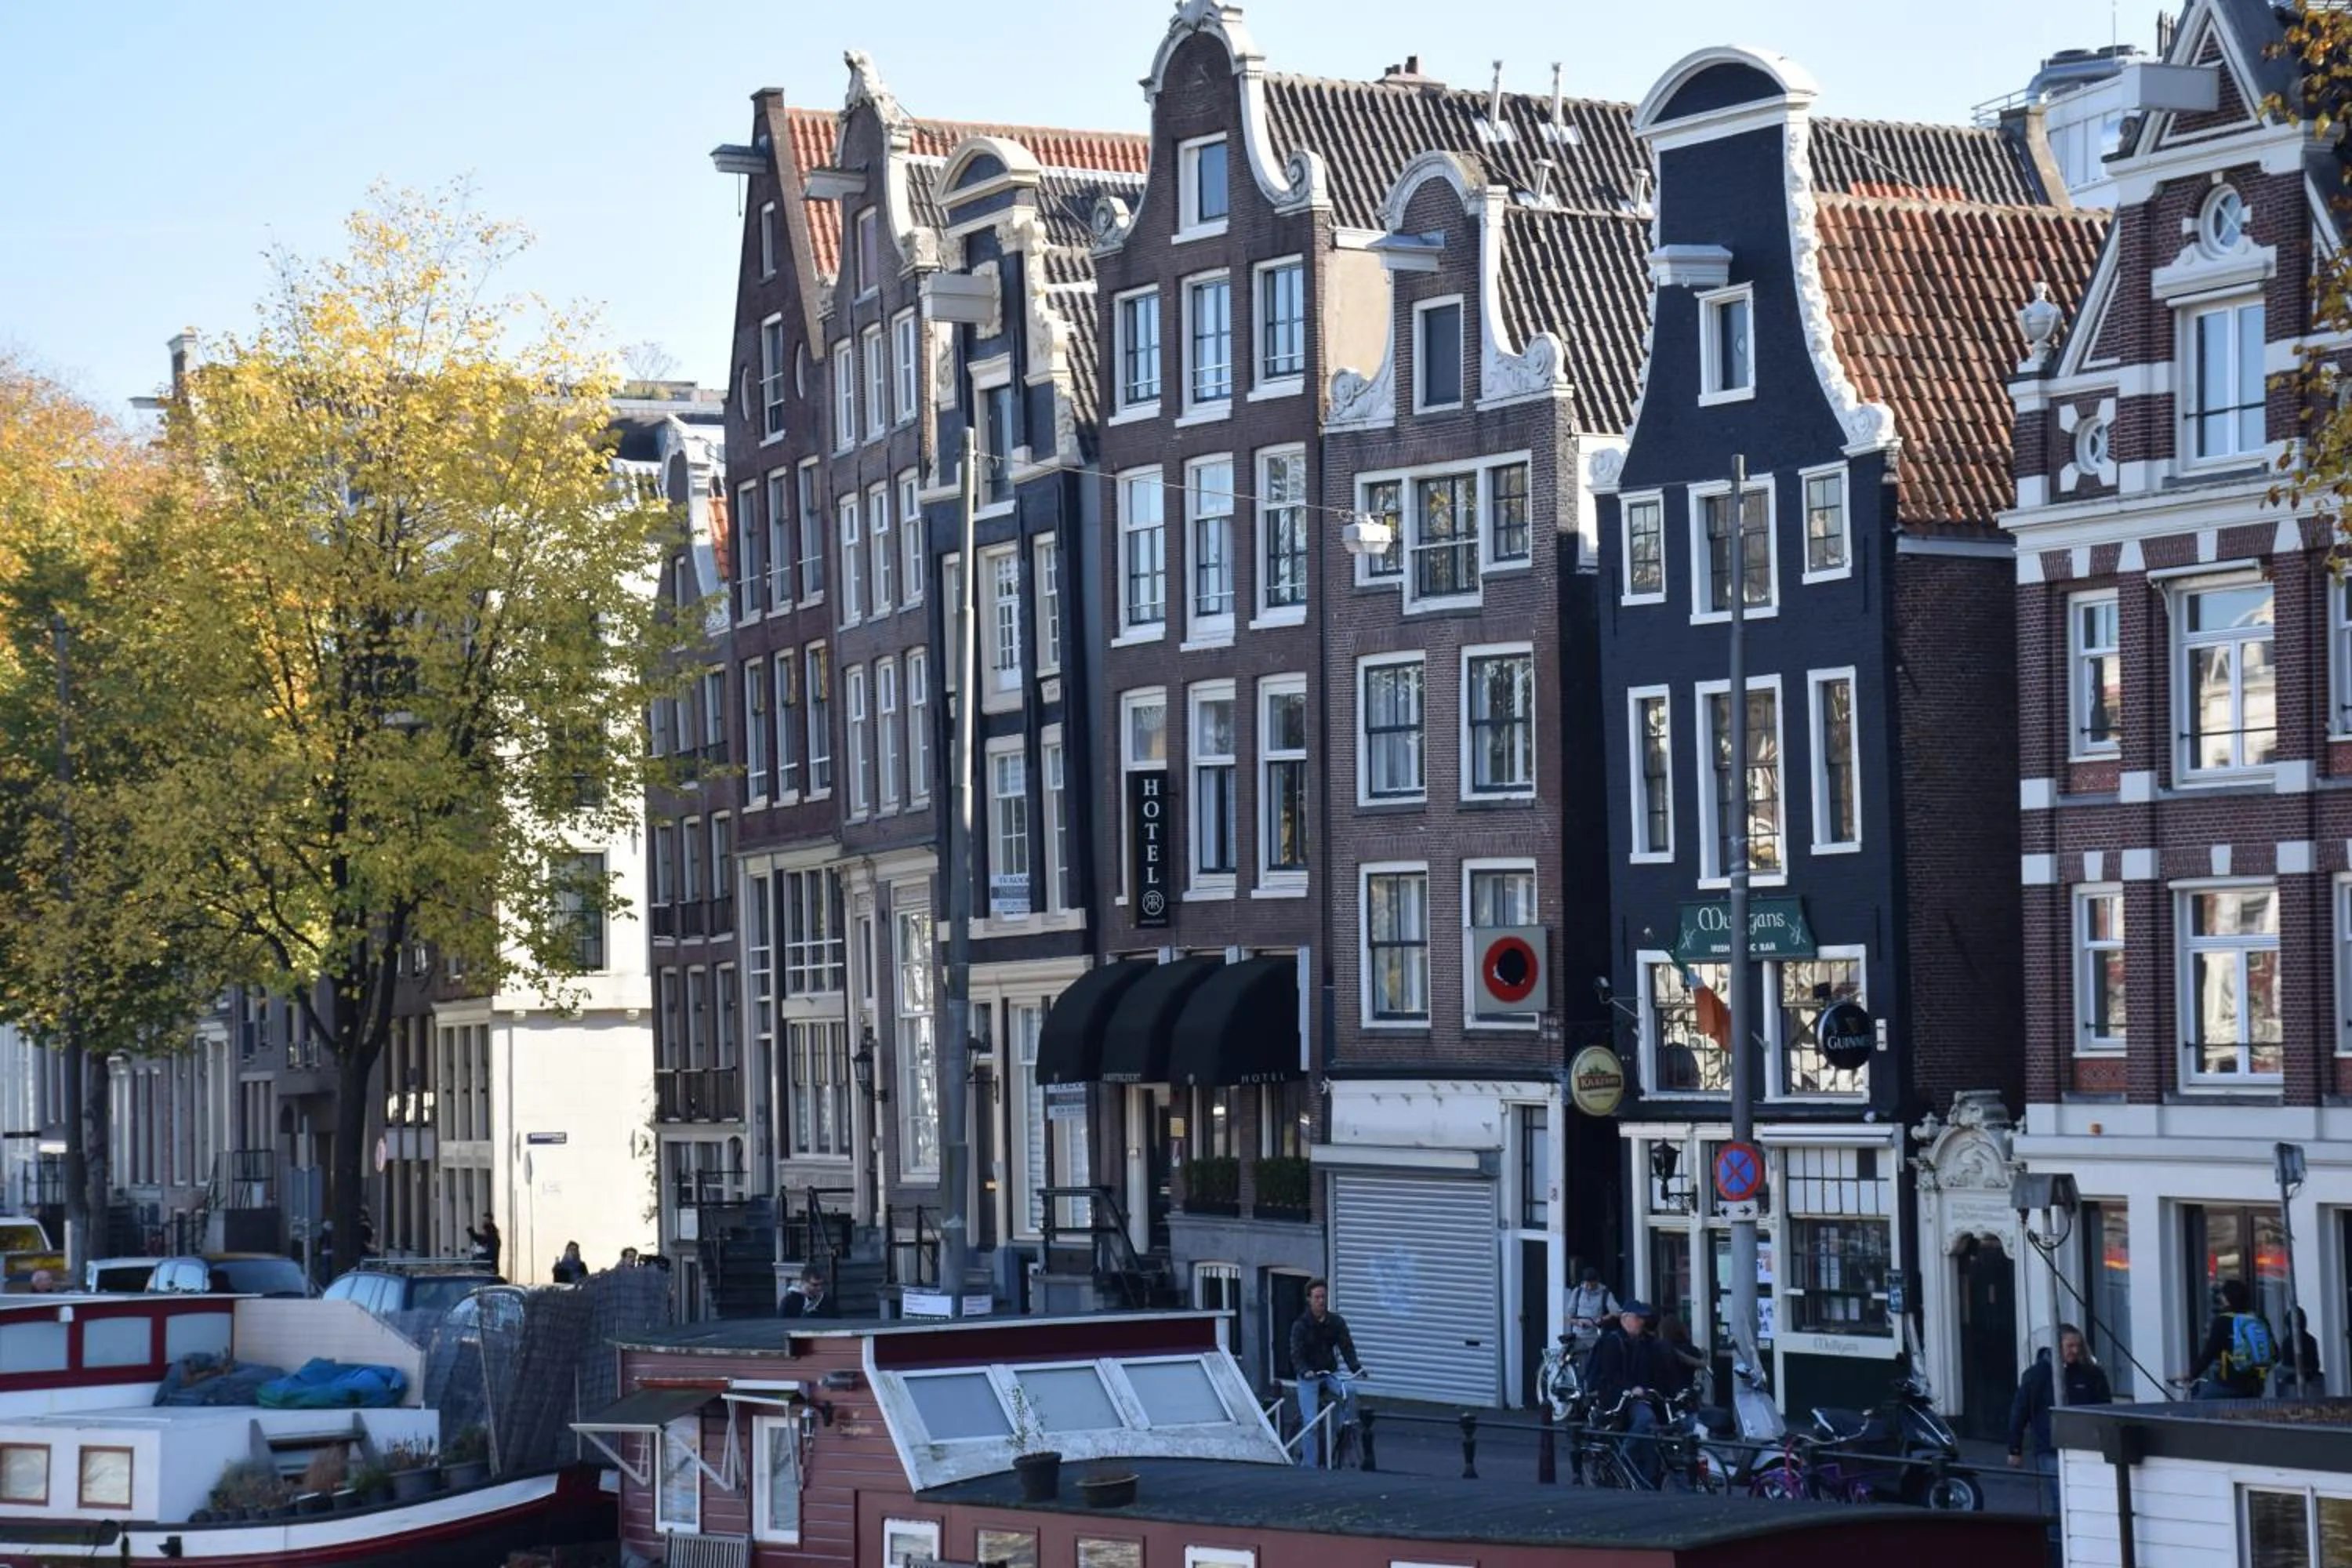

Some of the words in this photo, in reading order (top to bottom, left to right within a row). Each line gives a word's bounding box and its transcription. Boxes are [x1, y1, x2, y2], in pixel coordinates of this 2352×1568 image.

[1143, 779, 1160, 884] HOTEL
[1759, 942, 1777, 952] BAR
[1241, 1072, 1285, 1084] HOTEL
